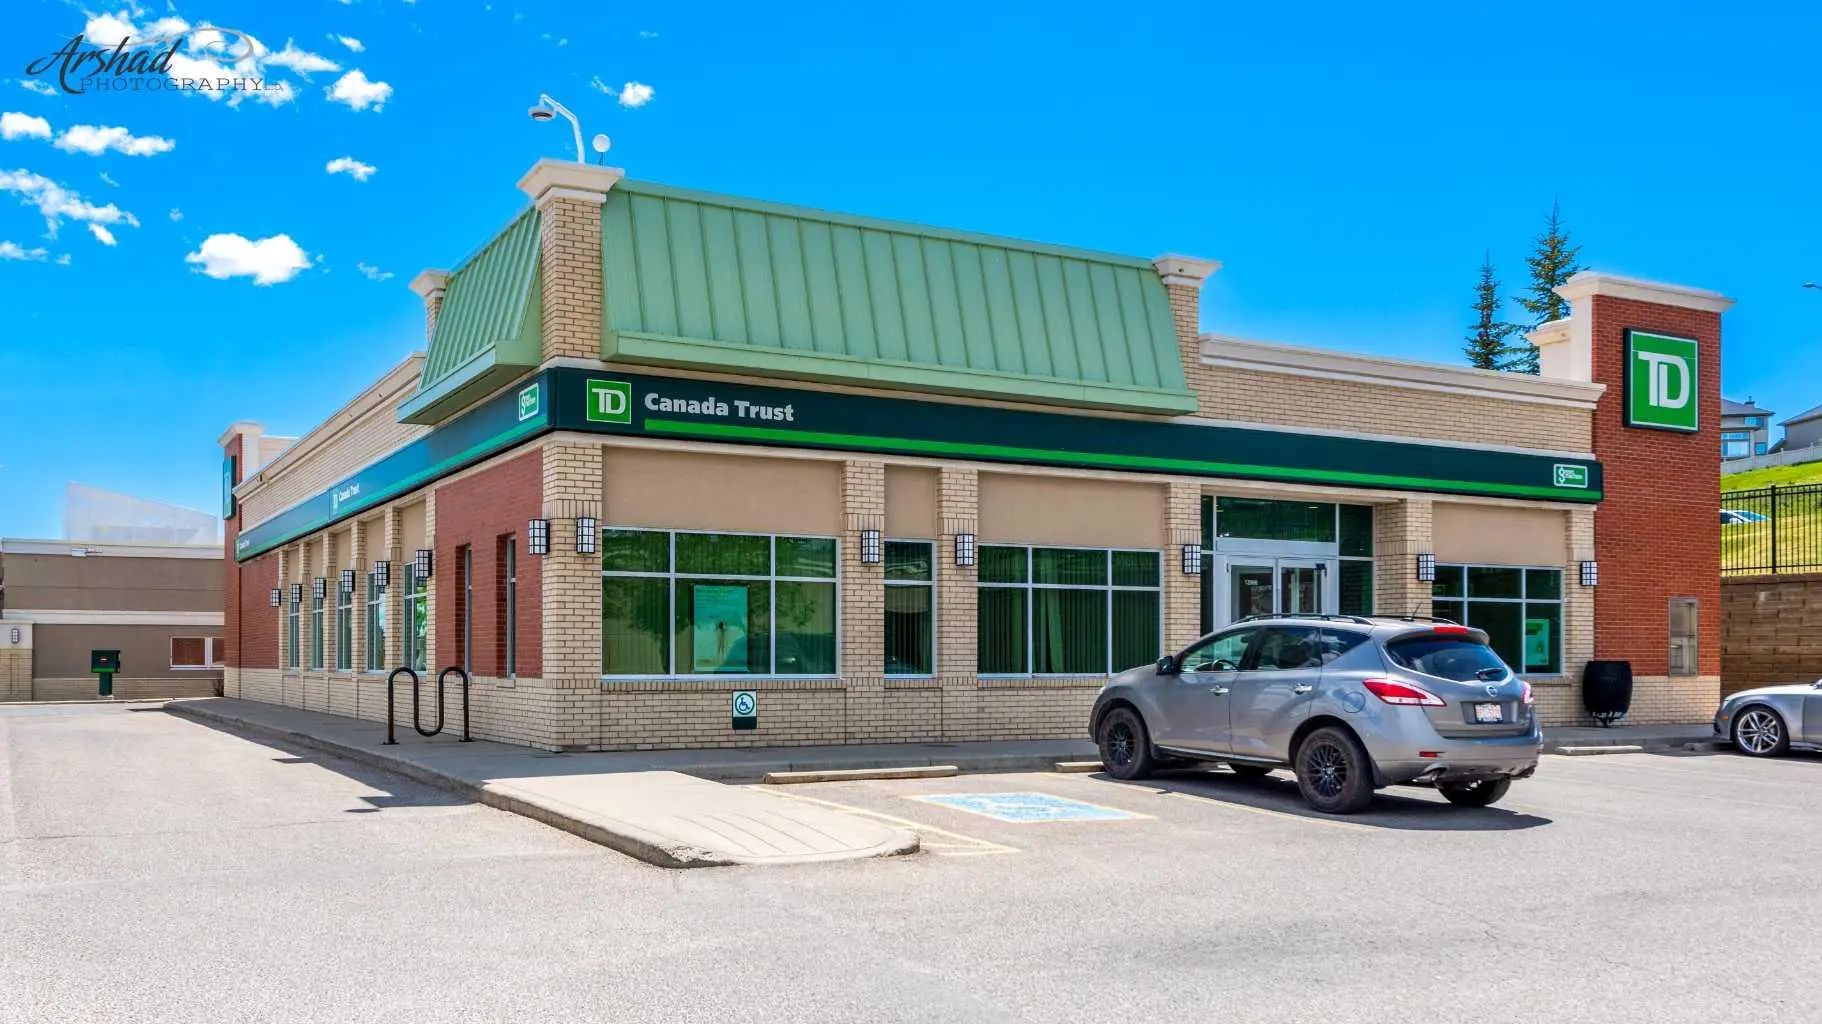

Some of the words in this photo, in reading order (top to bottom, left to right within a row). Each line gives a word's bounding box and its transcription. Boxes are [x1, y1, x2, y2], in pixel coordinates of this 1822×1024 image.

[1638, 351, 1690, 410] TD
[591, 388, 627, 415] TD
[644, 393, 729, 417] Canada
[734, 401, 795, 422] Trust
